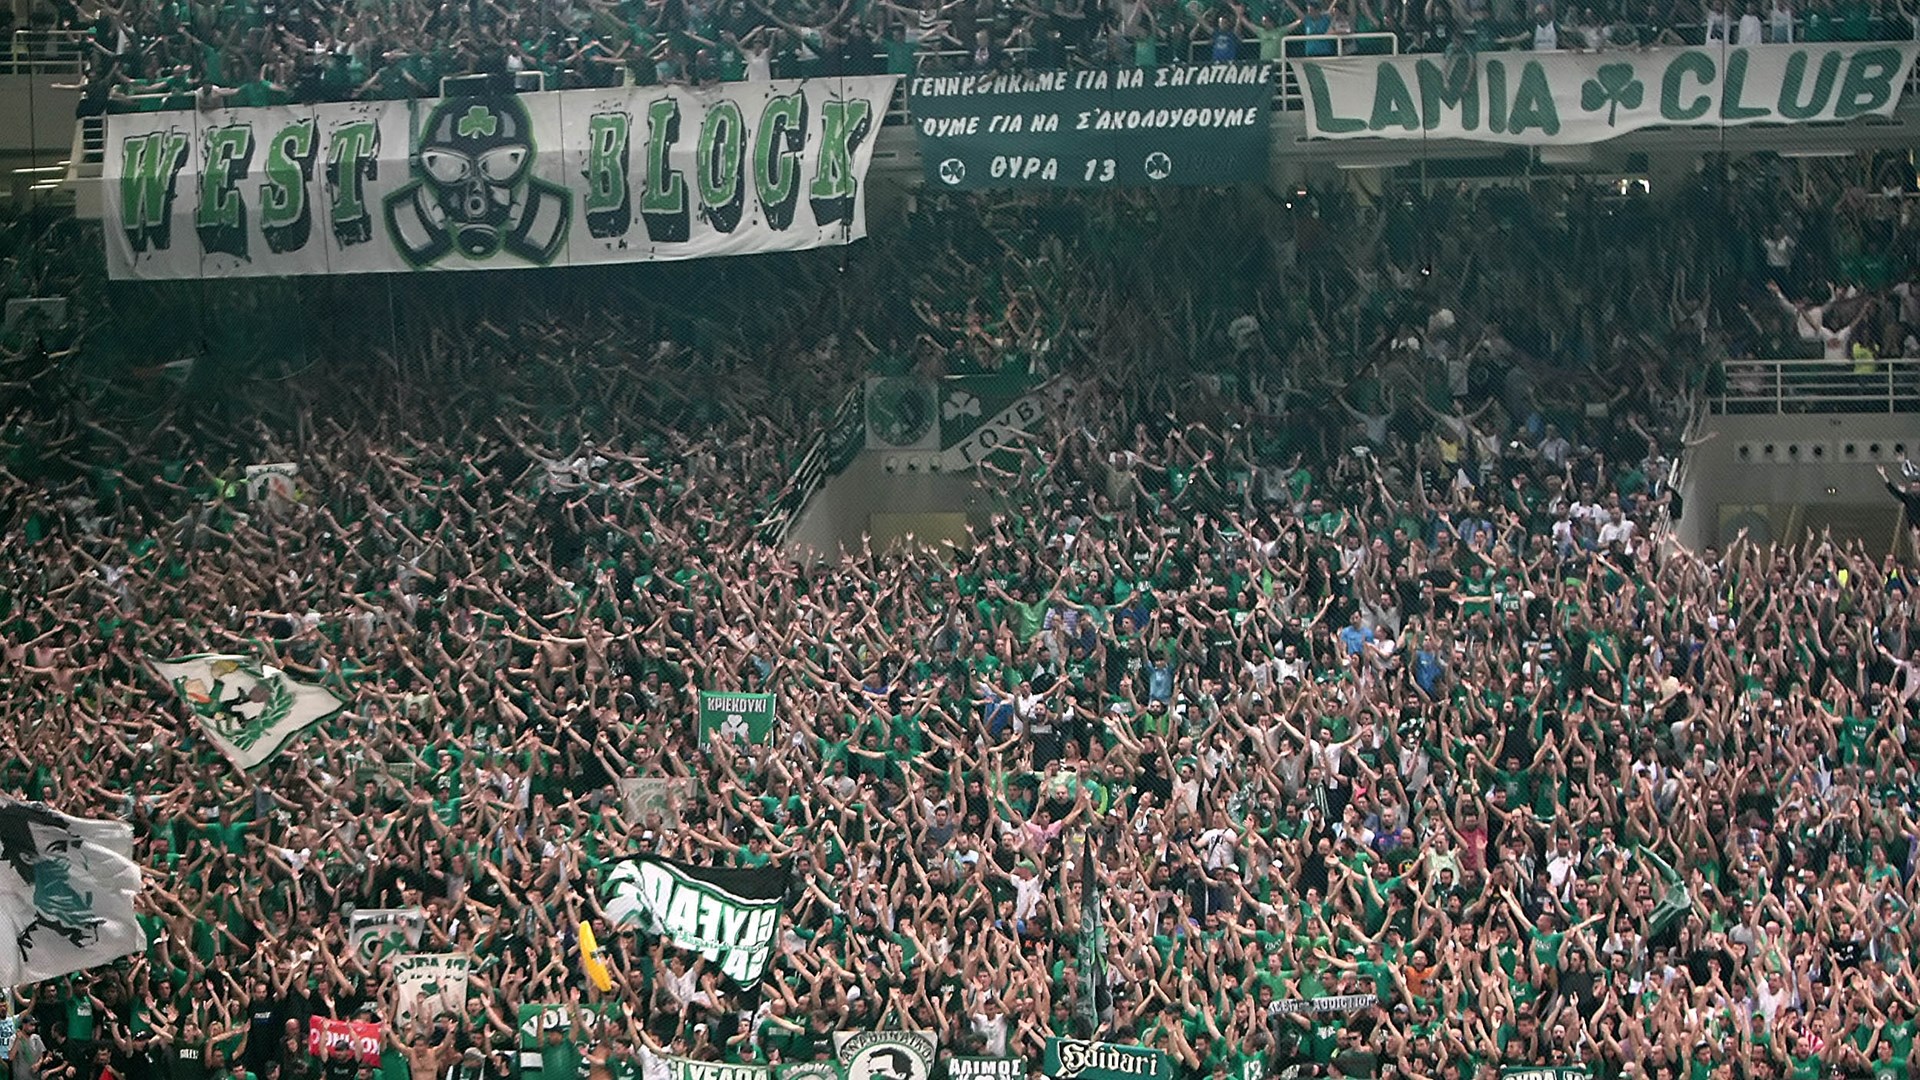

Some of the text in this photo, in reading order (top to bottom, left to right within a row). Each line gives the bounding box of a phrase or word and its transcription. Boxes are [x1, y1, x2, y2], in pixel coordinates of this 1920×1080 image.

[1076, 68, 1108, 91] ΓΙΑ
[1117, 68, 1144, 89] ΝΑ
[1302, 47, 1903, 137] LAMIA CLUB
[988, 114, 1023, 134] ΓΙΑ
[1030, 113, 1060, 133] ΝΑ
[121, 91, 872, 260] WEST BLOCK
[990, 155, 1116, 182] ΘΥΡΑ 13
[947, 1057, 1022, 1076] ΑΛΙΜΟΣ
